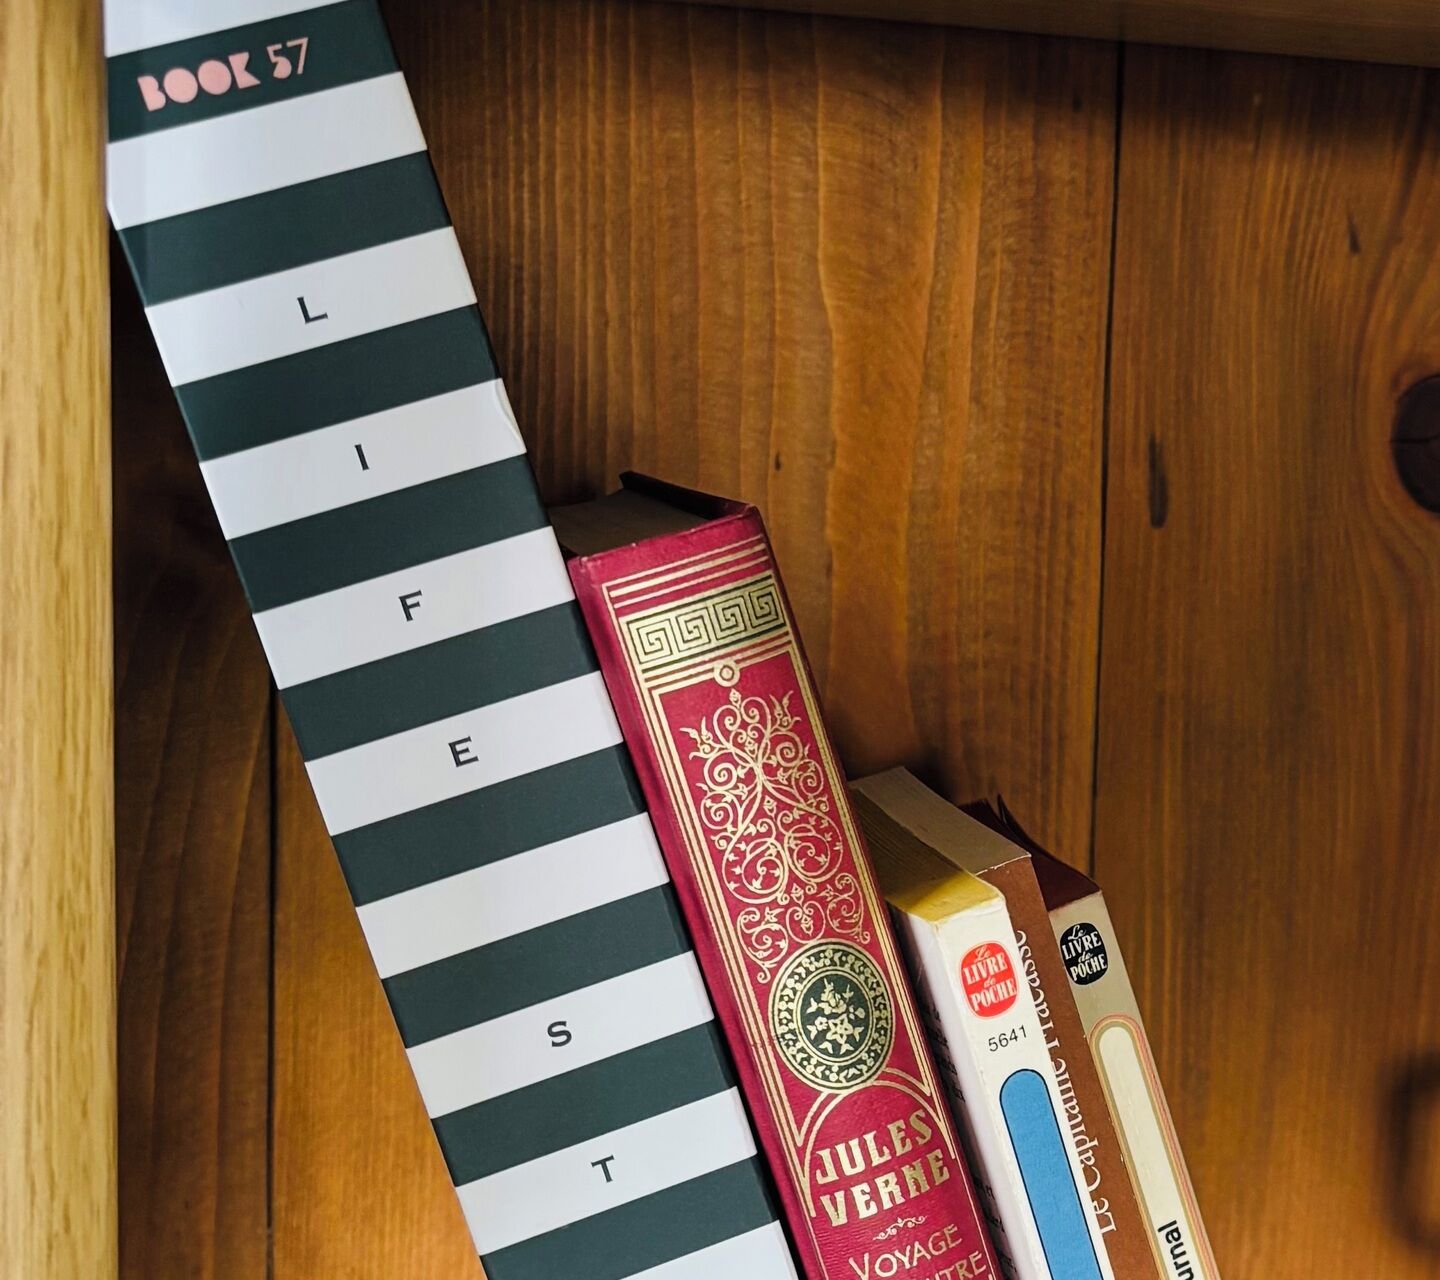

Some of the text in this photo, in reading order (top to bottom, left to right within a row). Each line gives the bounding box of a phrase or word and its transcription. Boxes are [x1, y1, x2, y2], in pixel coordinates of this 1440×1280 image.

[137, 37, 310, 112] BOOK 57
[1062, 930, 1102, 960] LIVRE
[1067, 924, 1086, 940] Le
[963, 951, 1008, 985] LIVRE
[974, 947, 991, 962] Le
[1070, 954, 1108, 982] POCHE
[1078, 951, 1093, 962] de
[970, 979, 1017, 1011] POCHE
[983, 976, 995, 988] de
[988, 1024, 1028, 1052] 5641
[816, 1109, 934, 1183] JULES
[819, 1149, 951, 1226] VERNE
